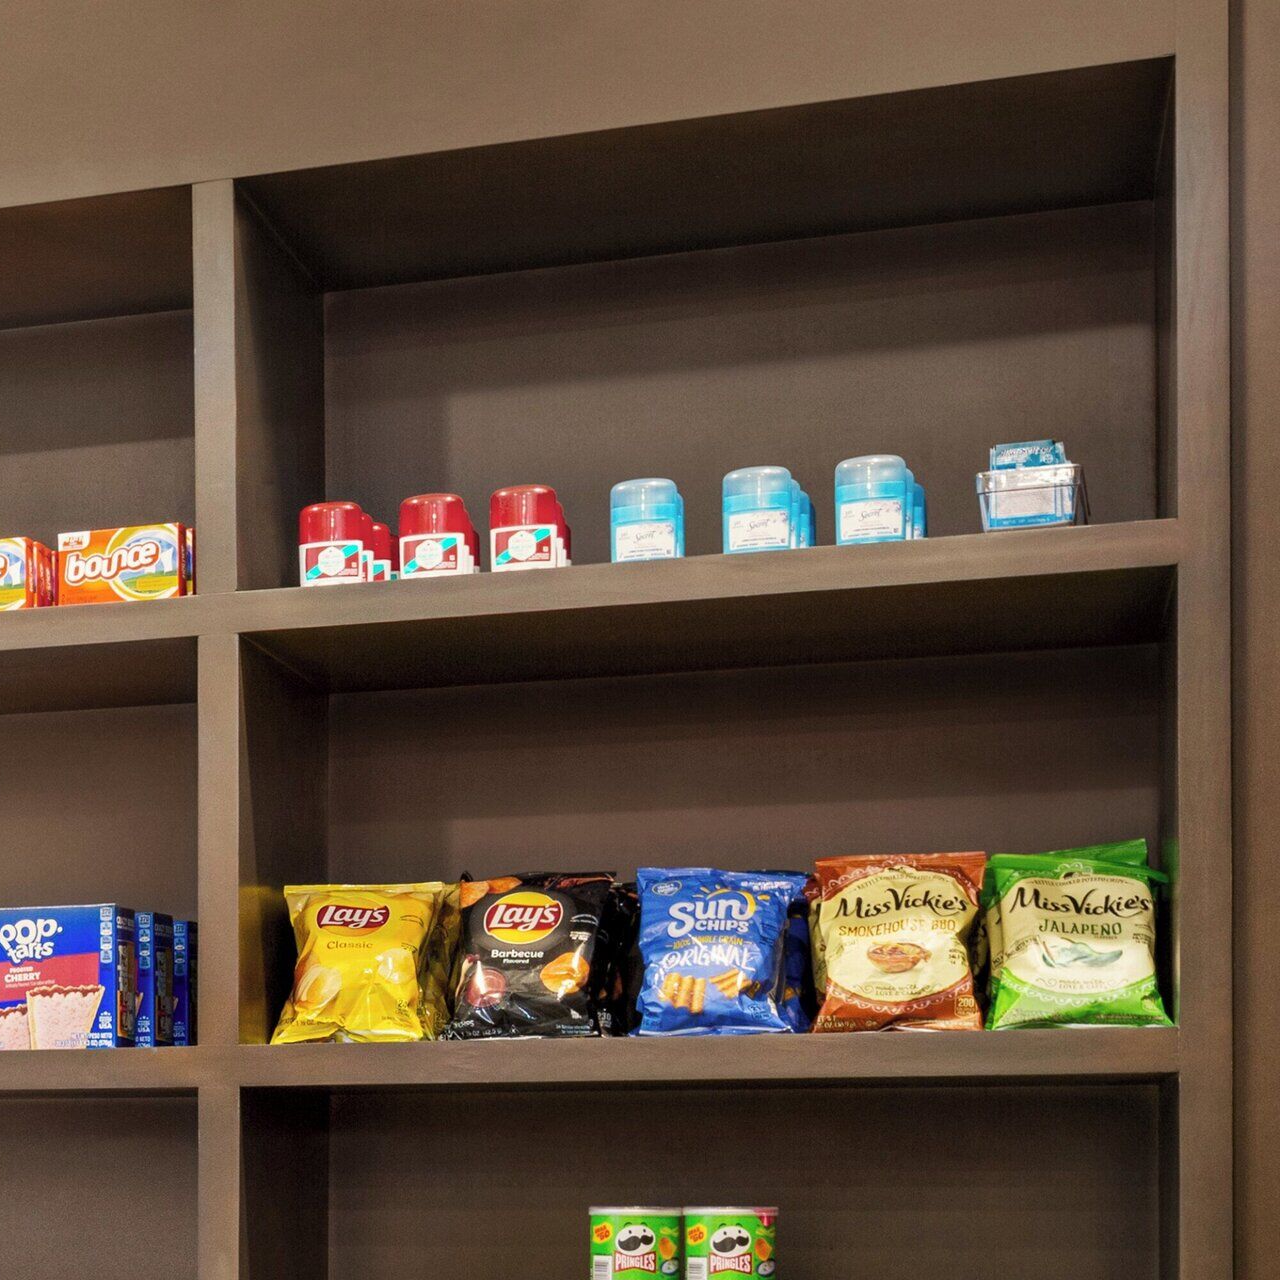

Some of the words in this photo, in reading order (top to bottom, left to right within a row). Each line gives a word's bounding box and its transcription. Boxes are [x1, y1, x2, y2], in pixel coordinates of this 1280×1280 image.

[67, 542, 159, 583] bounce
[834, 897, 891, 919] Miss
[886, 883, 968, 917] Vickie's
[1009, 886, 1070, 913] Miss
[1062, 888, 1151, 918] Vickie's
[320, 904, 386, 929] Lay's
[489, 903, 560, 932] Lay's
[694, 919, 750, 933] CHIPS
[838, 918, 926, 937] SMOKEHOUSE
[931, 918, 956, 932] BBQ
[326, 940, 374, 950] Classic
[491, 949, 544, 959] Barbecue
[4, 971, 41, 983] CHERRY
[615, 1253, 655, 1272] PRINGLES
[709, 1256, 751, 1273] PRINGLES
